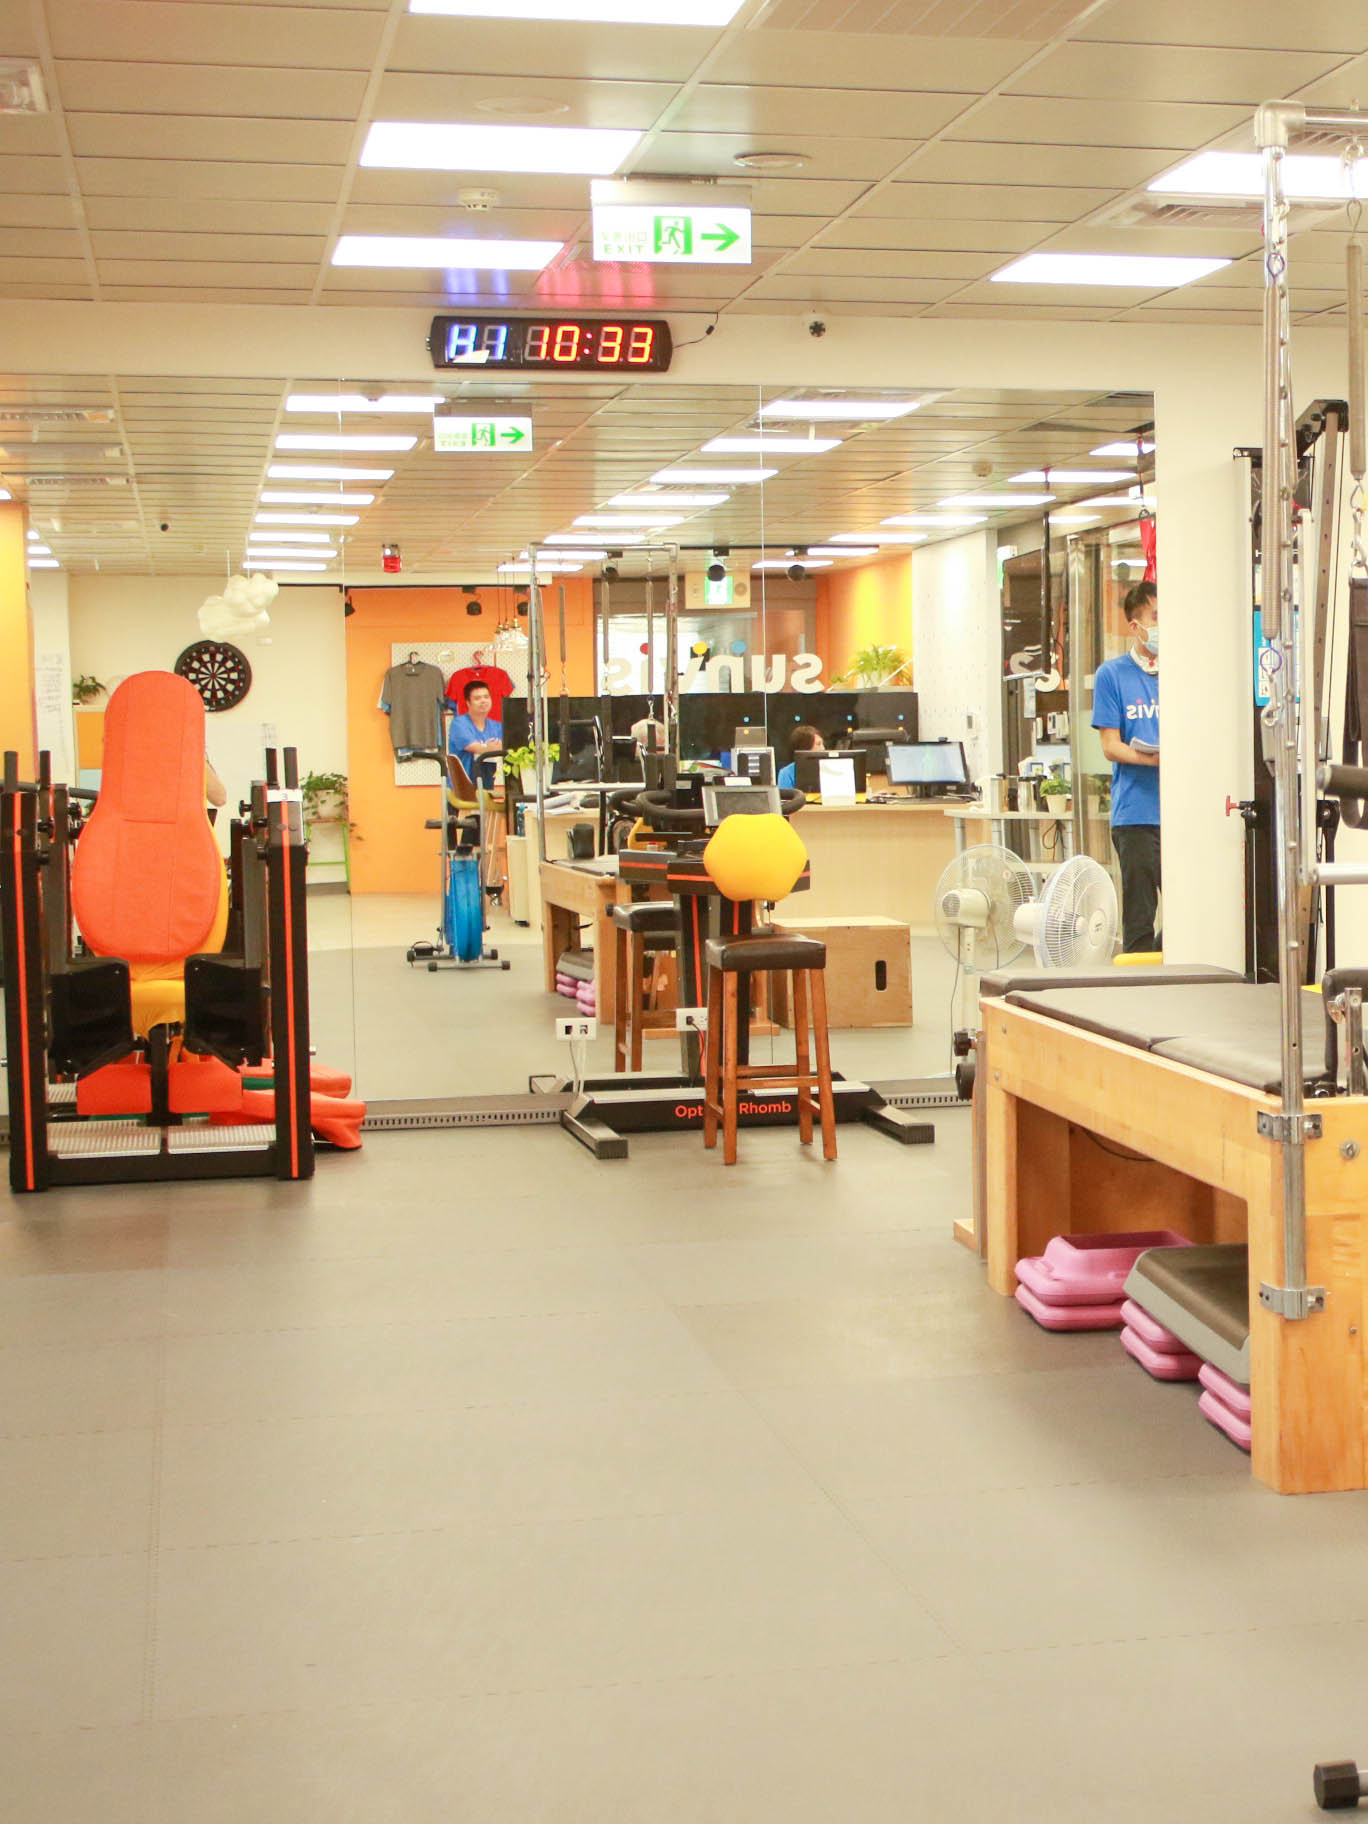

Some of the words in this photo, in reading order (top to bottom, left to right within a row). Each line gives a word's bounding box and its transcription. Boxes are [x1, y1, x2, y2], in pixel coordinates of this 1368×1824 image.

[603, 244, 646, 255] EXIT
[541, 325, 655, 363] 10:33
[674, 1104, 705, 1119] Opt
[739, 1100, 792, 1115] Rhomb
